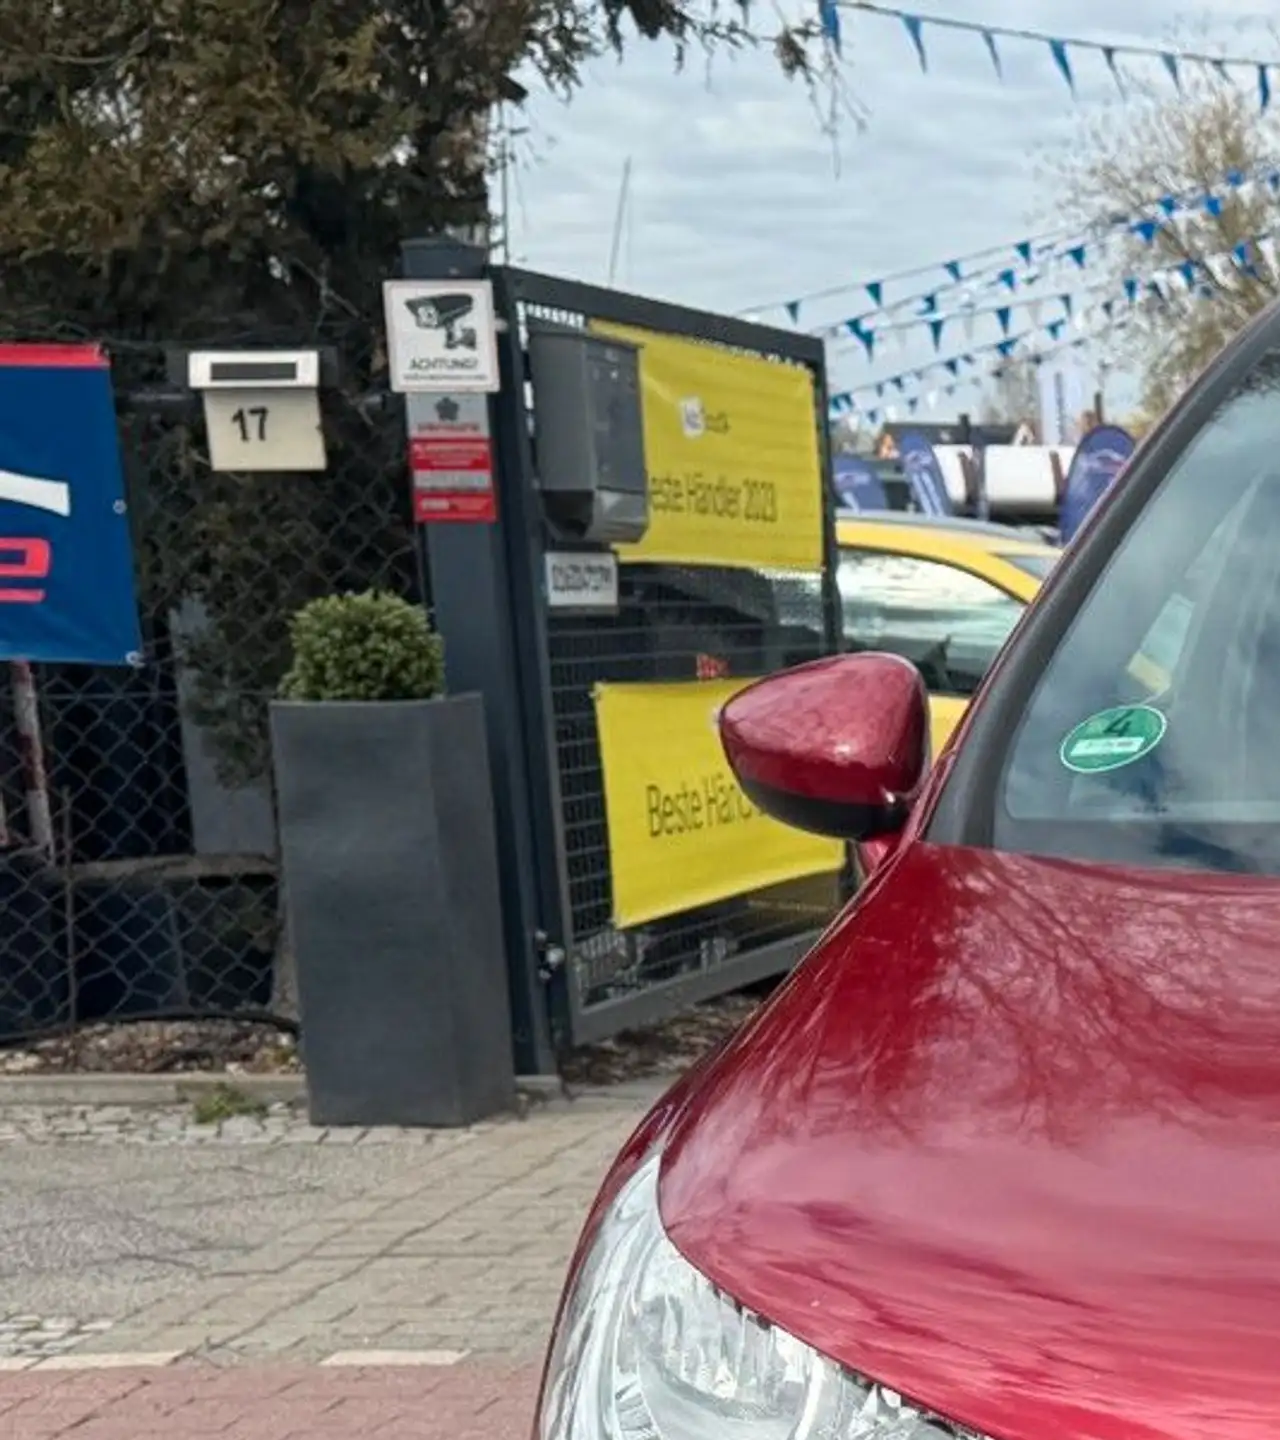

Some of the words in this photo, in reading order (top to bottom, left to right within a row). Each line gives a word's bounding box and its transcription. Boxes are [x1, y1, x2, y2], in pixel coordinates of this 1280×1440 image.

[231, 406, 269, 443] 17
[649, 474, 684, 514] este
[1103, 709, 1135, 738] 4
[646, 782, 703, 838] Beste
